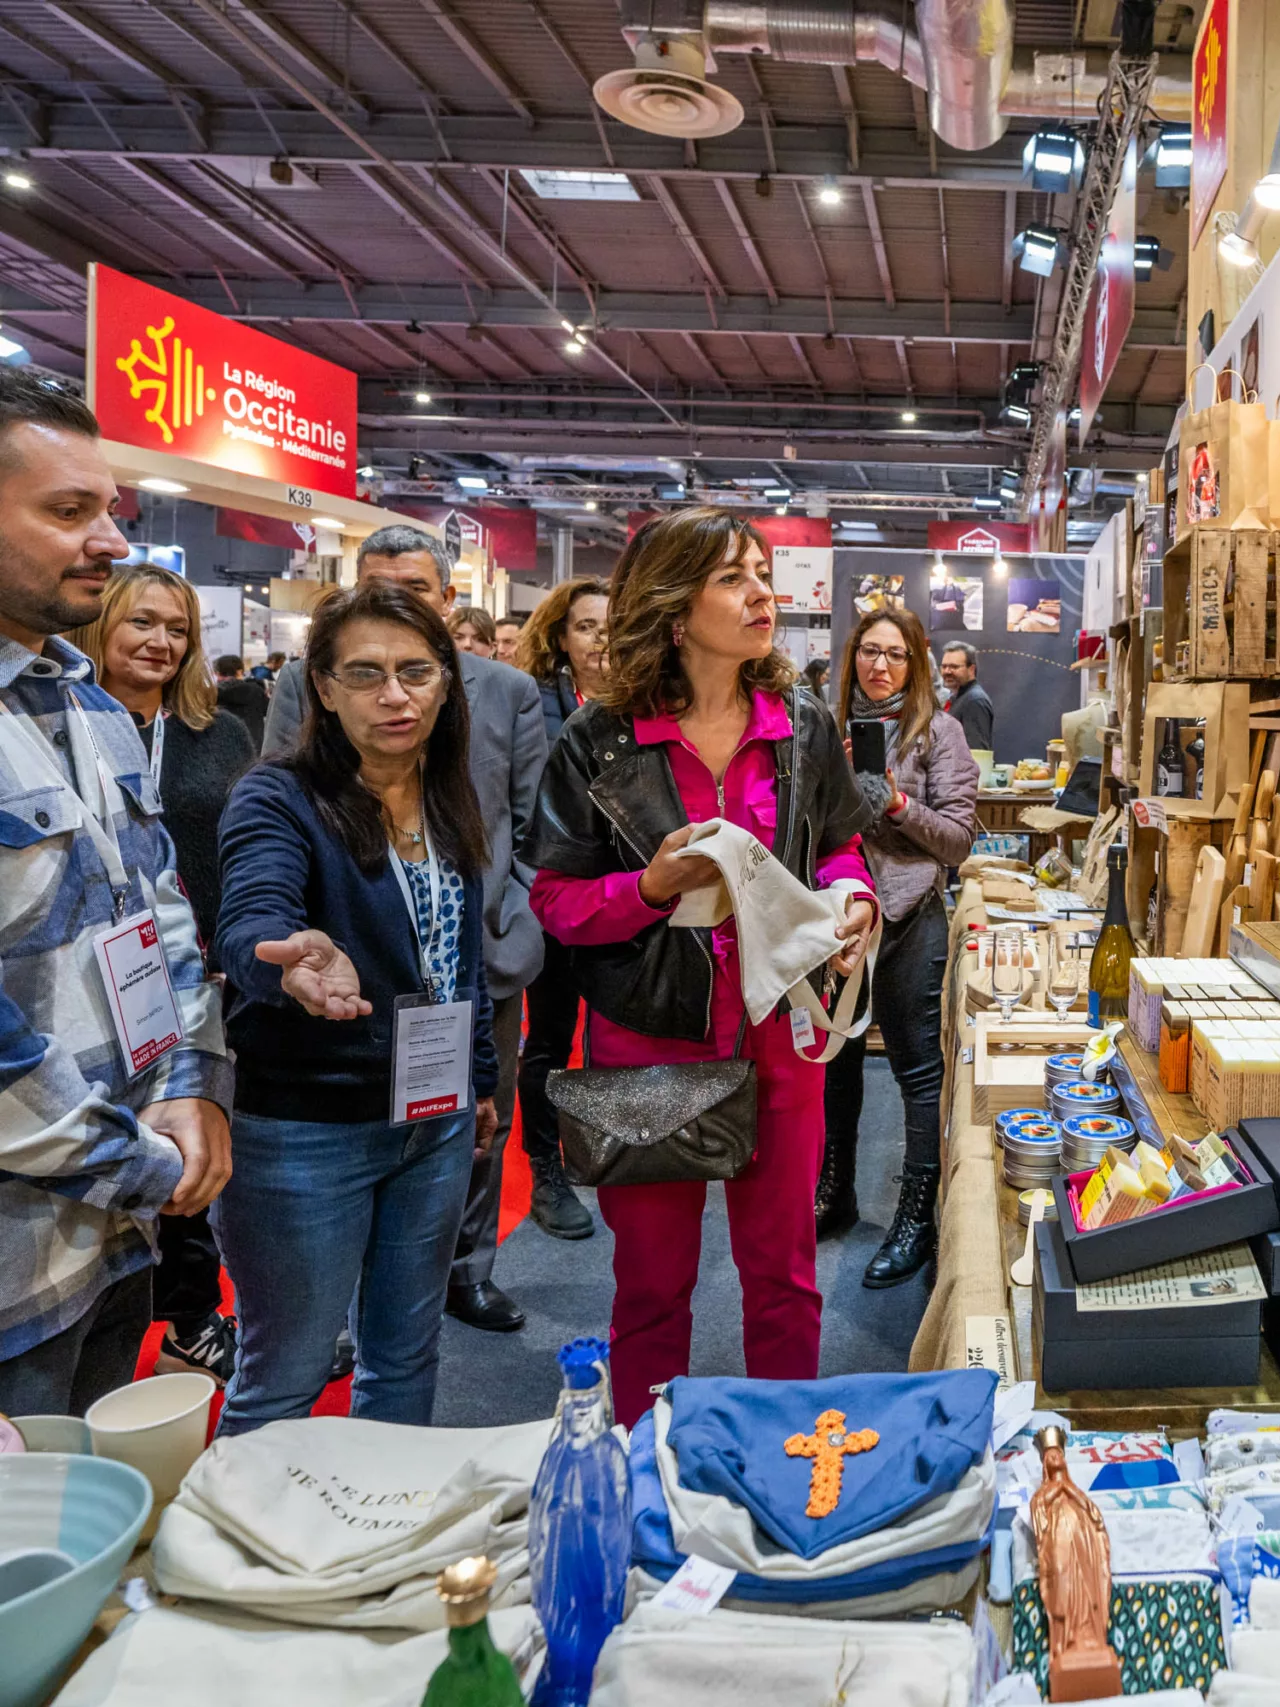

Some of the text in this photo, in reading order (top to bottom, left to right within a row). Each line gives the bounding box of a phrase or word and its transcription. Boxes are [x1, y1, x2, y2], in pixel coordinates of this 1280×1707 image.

[224, 362, 295, 403] La Région
[223, 388, 346, 451] Occitanie
[282, 439, 346, 469] Méditerranée
[288, 488, 312, 507] K39
[125, 960, 153, 980] La boutique
[119, 974, 144, 993] éphémère
[134, 1050, 151, 1067] MADE
[155, 1033, 176, 1053] FRANCE
[411, 1102, 453, 1115] #MIFExpo
[994, 1318, 1007, 1341] Coffret
[996, 1342, 1009, 1384] découverte
[287, 1464, 318, 1489] JE
[359, 1489, 438, 1507] LUND
